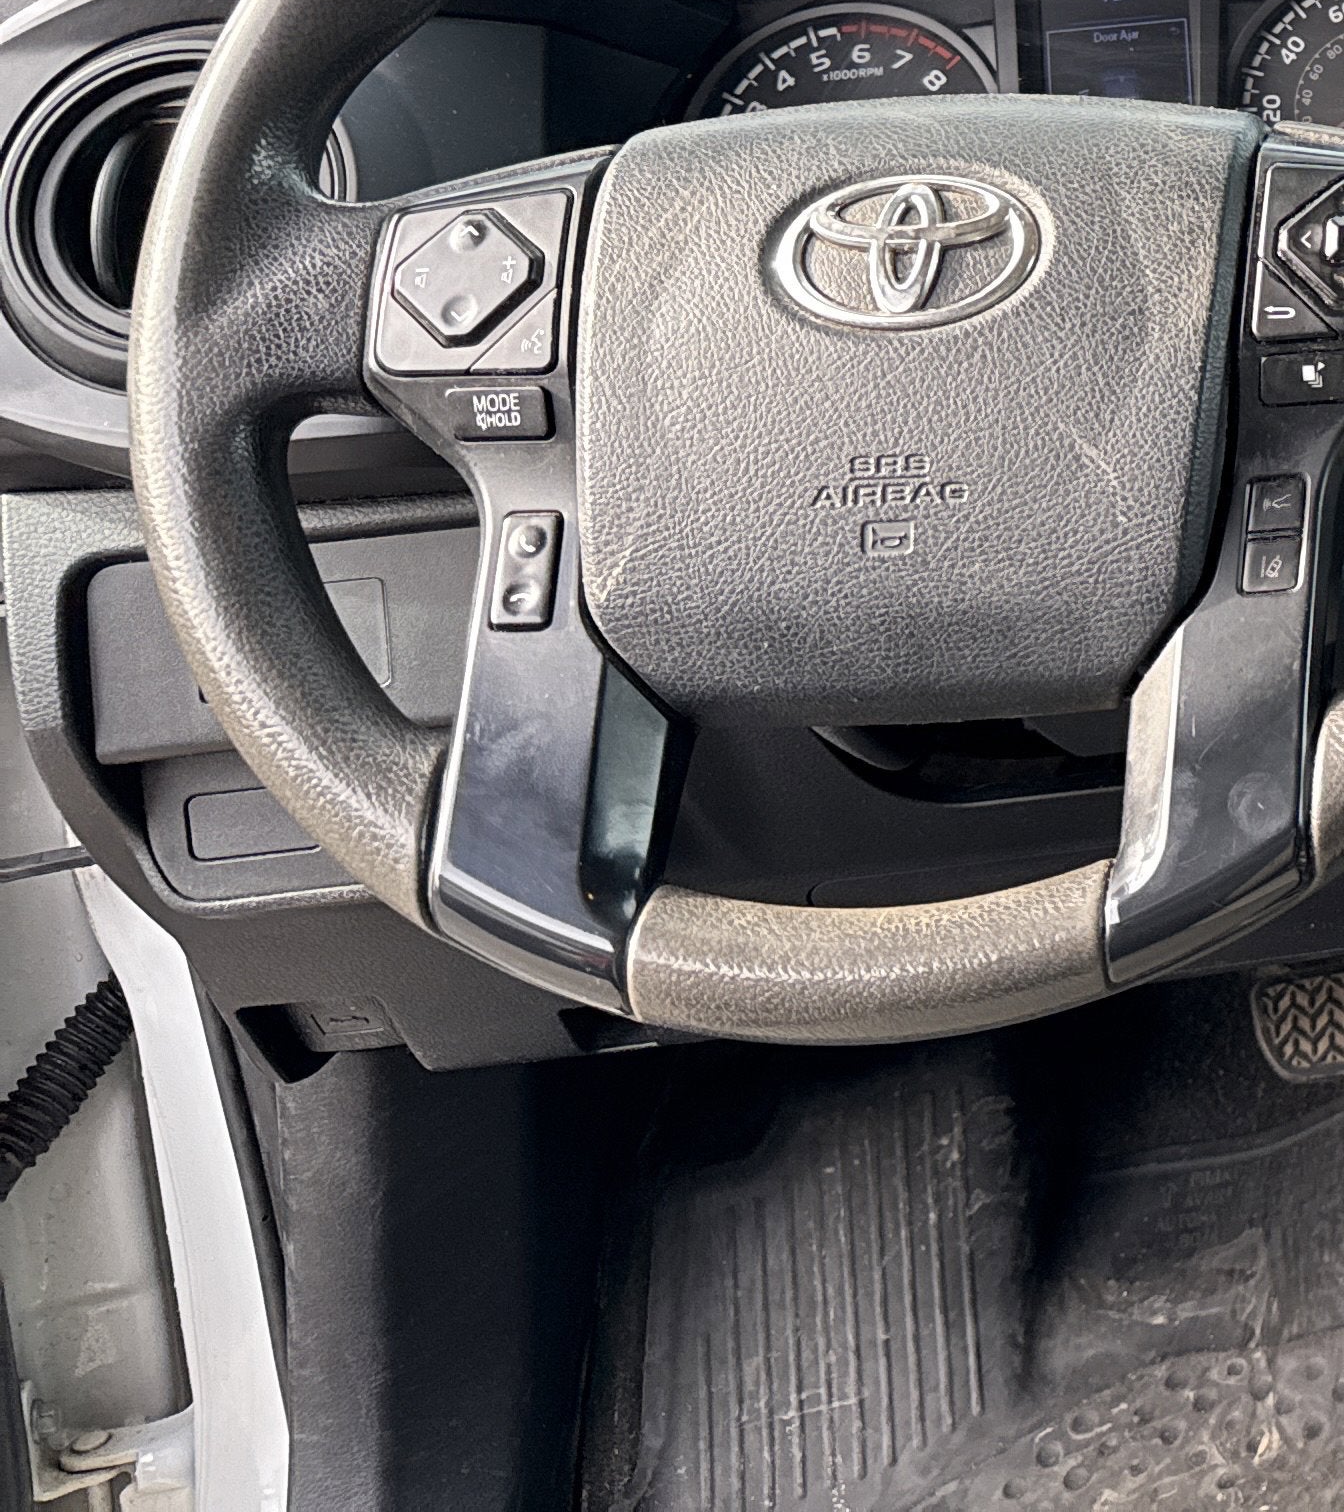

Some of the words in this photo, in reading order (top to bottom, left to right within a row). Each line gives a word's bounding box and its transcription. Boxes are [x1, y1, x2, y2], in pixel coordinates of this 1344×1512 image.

[1093, 32, 1118, 44] Door
[1119, 29, 1140, 43] Ajar
[851, 43, 872, 64] 6
[890, 49, 914, 70] 7
[1280, 35, 1306, 65] 40
[1326, 44, 1343, 60] 80
[809, 50, 832, 73] 5
[776, 69, 796, 92] 4
[922, 69, 948, 92] 8
[1309, 64, 1324, 81] 60
[1302, 89, 1313, 106] 40
[1262, 94, 1281, 123] 20
[472, 392, 521, 412] MODE
[487, 412, 521, 427] HOLD
[850, 453, 931, 476] SRS
[811, 481, 970, 507] AIRBAG
